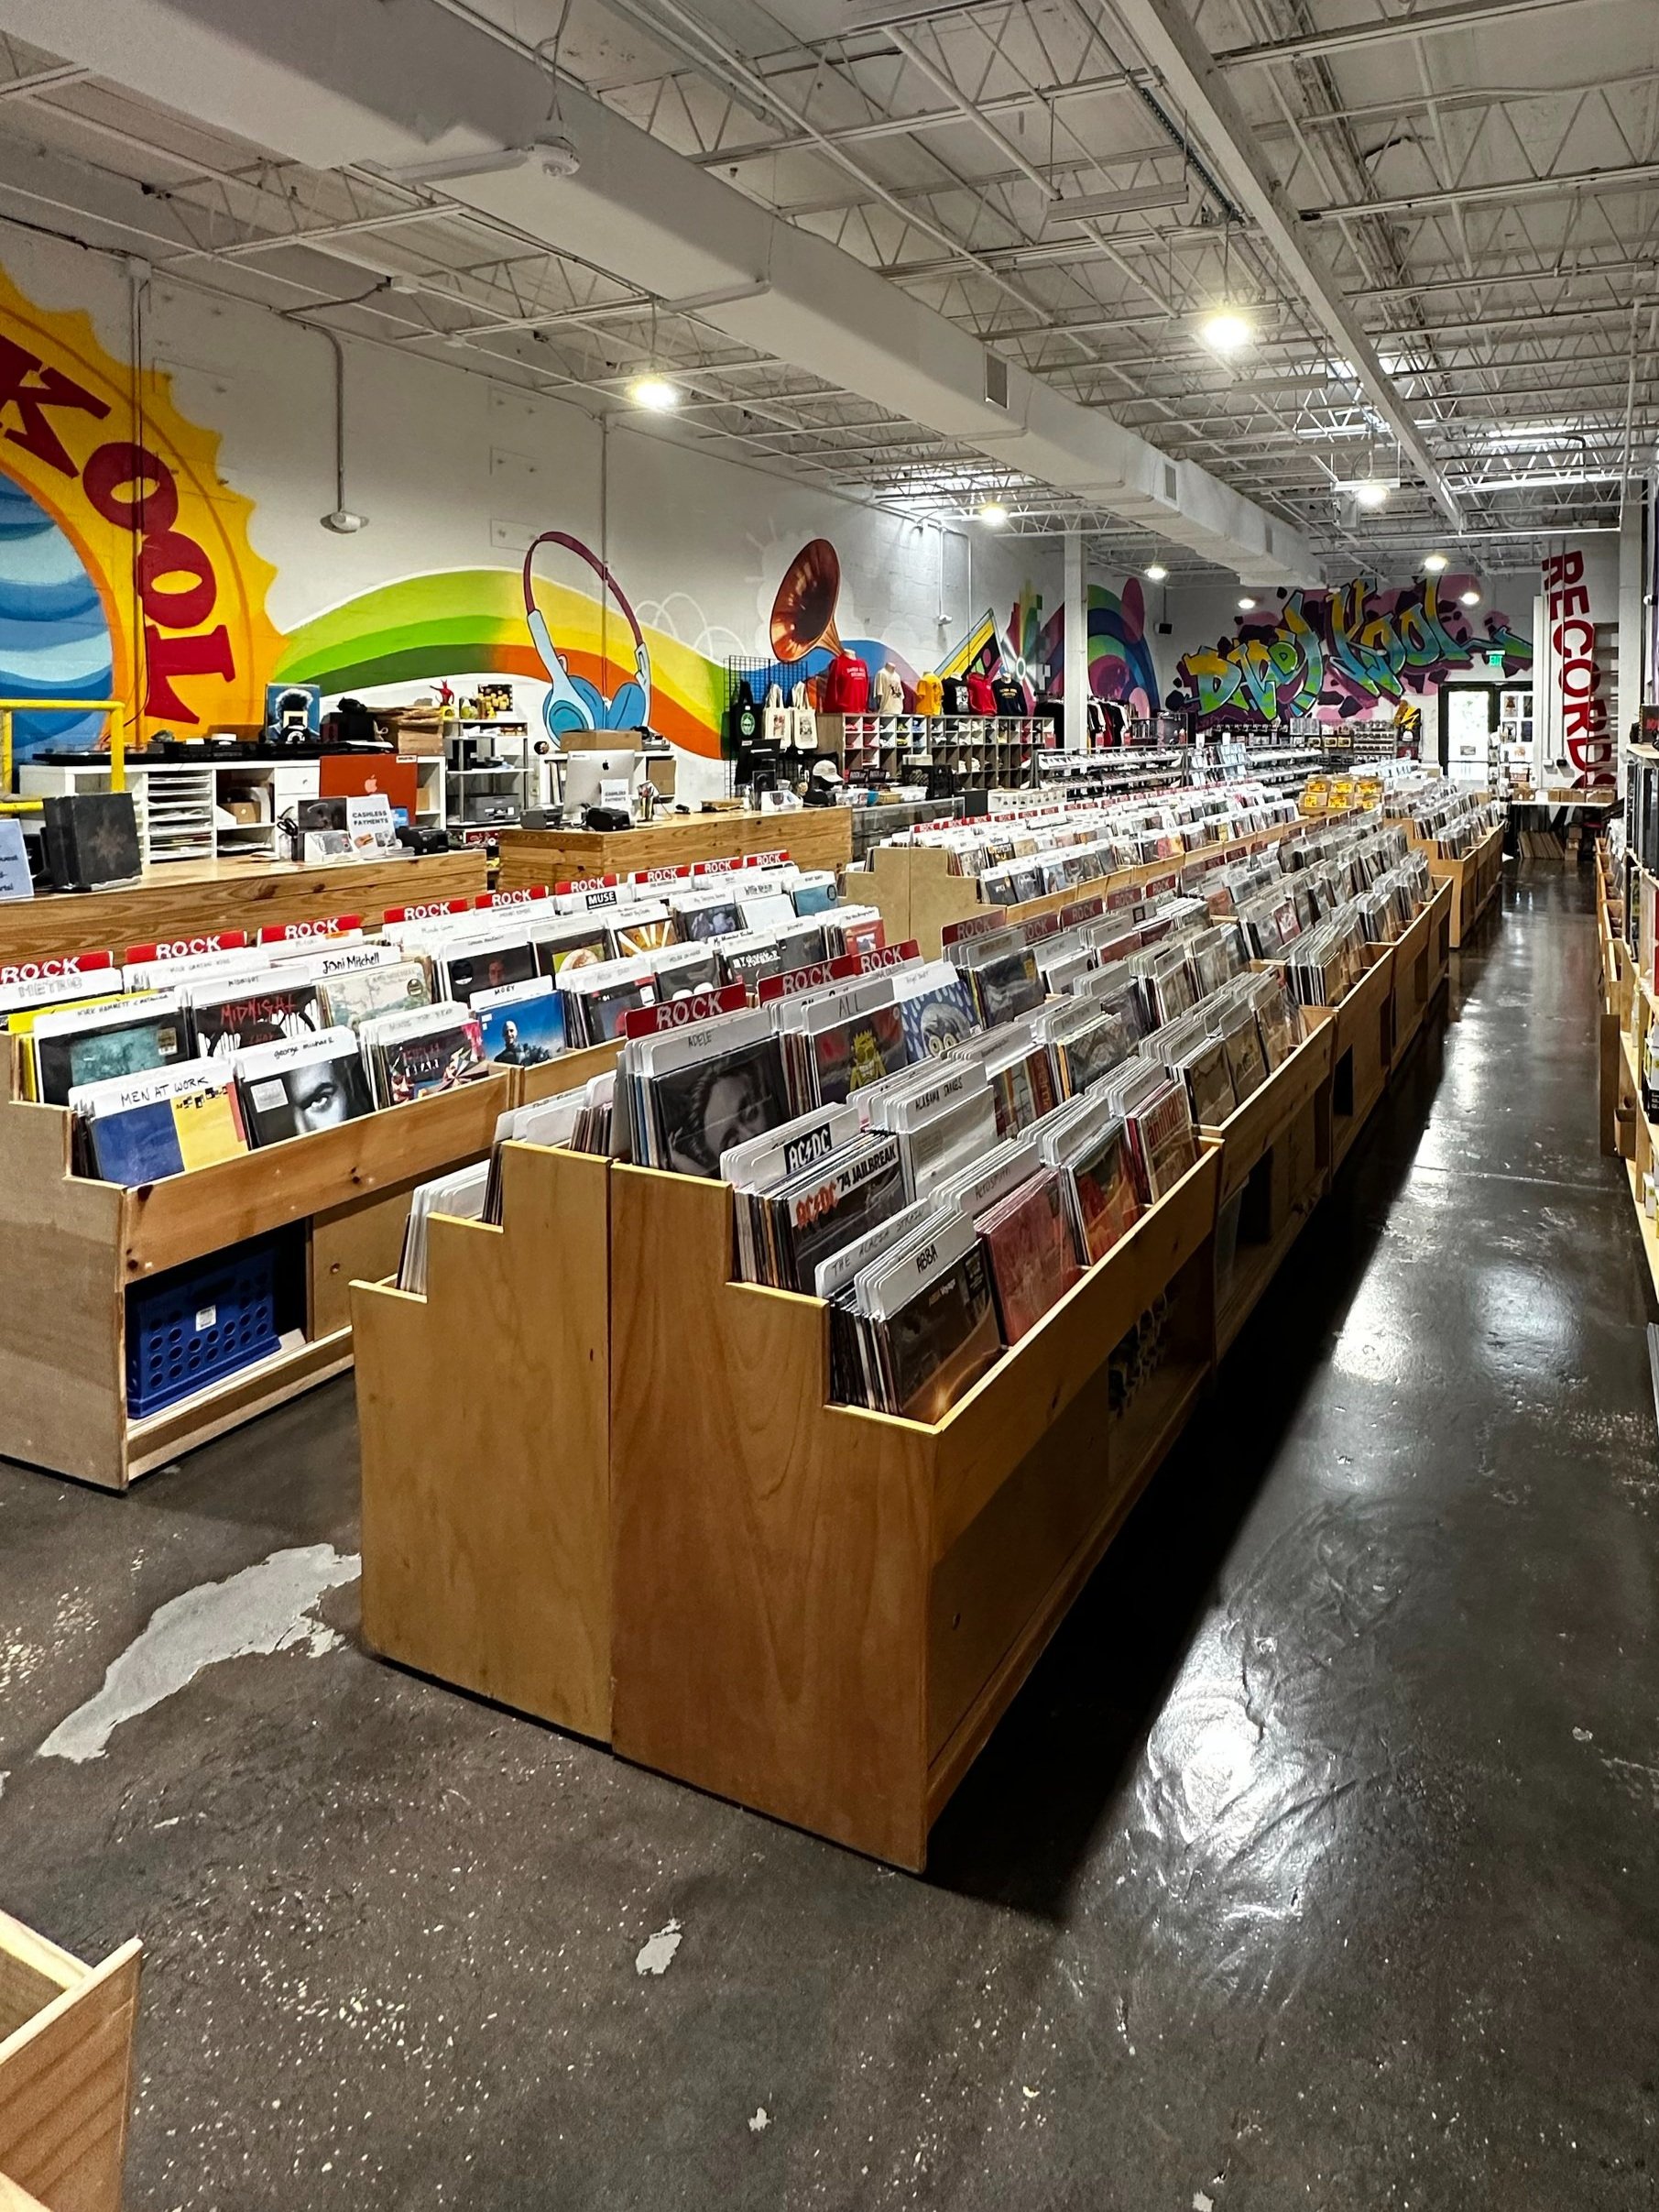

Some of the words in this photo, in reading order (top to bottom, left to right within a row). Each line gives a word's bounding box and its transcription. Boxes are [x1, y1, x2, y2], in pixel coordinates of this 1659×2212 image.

[0, 334, 235, 724] KOOL
[352, 810, 387, 818] CASHLESS
[704, 860, 732, 872] ROCK
[758, 853, 780, 865] ROCK
[571, 876, 606, 893] ROCK
[648, 869, 678, 882] ROCK
[1152, 878, 1171, 892] ROCK
[492, 889, 531, 907] ROCK
[587, 892, 616, 905] MUSE
[1115, 892, 1135, 906] ROCK
[404, 903, 451, 922] ROCK
[1073, 903, 1096, 923] ROCK
[285, 918, 339, 940] ROCK
[957, 916, 991, 940] ROCK
[157, 936, 221, 959] ROCK
[1, 956, 80, 985] ROCK
[322, 958, 345, 974] Joni
[346, 952, 380, 969] Mitchell
[861, 946, 904, 975] ROCK
[18, 977, 82, 998] METRIC
[229, 975, 259, 987] MIDNIGHT
[782, 963, 835, 995] ROCK
[495, 985, 515, 996] MOBY
[78, 1007, 95, 1016] KIRK
[99, 1001, 129, 1013] HAMMETT
[220, 993, 297, 1031] MIDNIGHT
[657, 991, 723, 1031] ROCK
[839, 992, 860, 1017] ALL
[275, 1044, 299, 1059] george
[302, 1037, 334, 1049] michael
[688, 1030, 713, 1048] ADELE
[121, 1089, 150, 1107] MEN
[155, 1083, 169, 1096] AT
[174, 1076, 209, 1093] WORK
[852, 1145, 896, 1187] JAILBREAK
[832, 1256, 851, 1276] THE
[916, 1244, 938, 1274] ABBA
